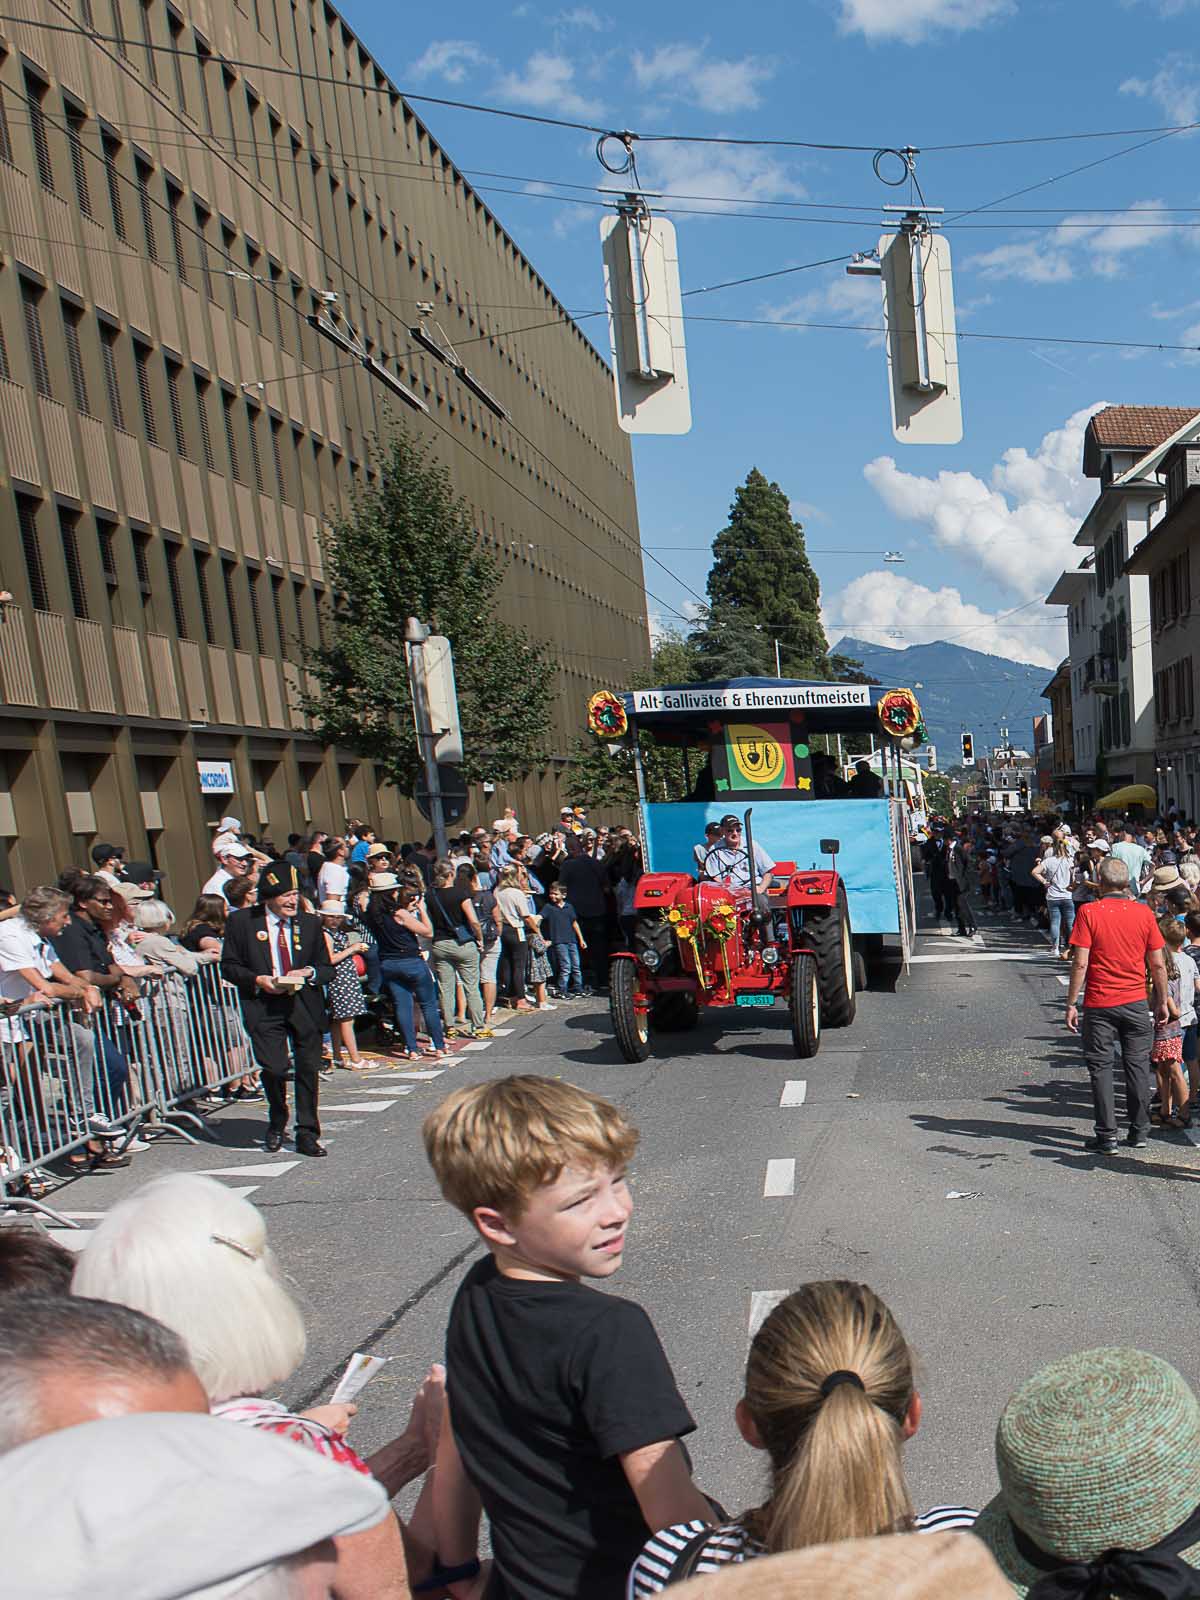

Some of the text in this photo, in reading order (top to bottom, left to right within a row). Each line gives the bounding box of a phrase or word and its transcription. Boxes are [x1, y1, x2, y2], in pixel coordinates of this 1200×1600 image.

[640, 690, 865, 709] Alt-Galliväter & Ehrenzunftmeister
